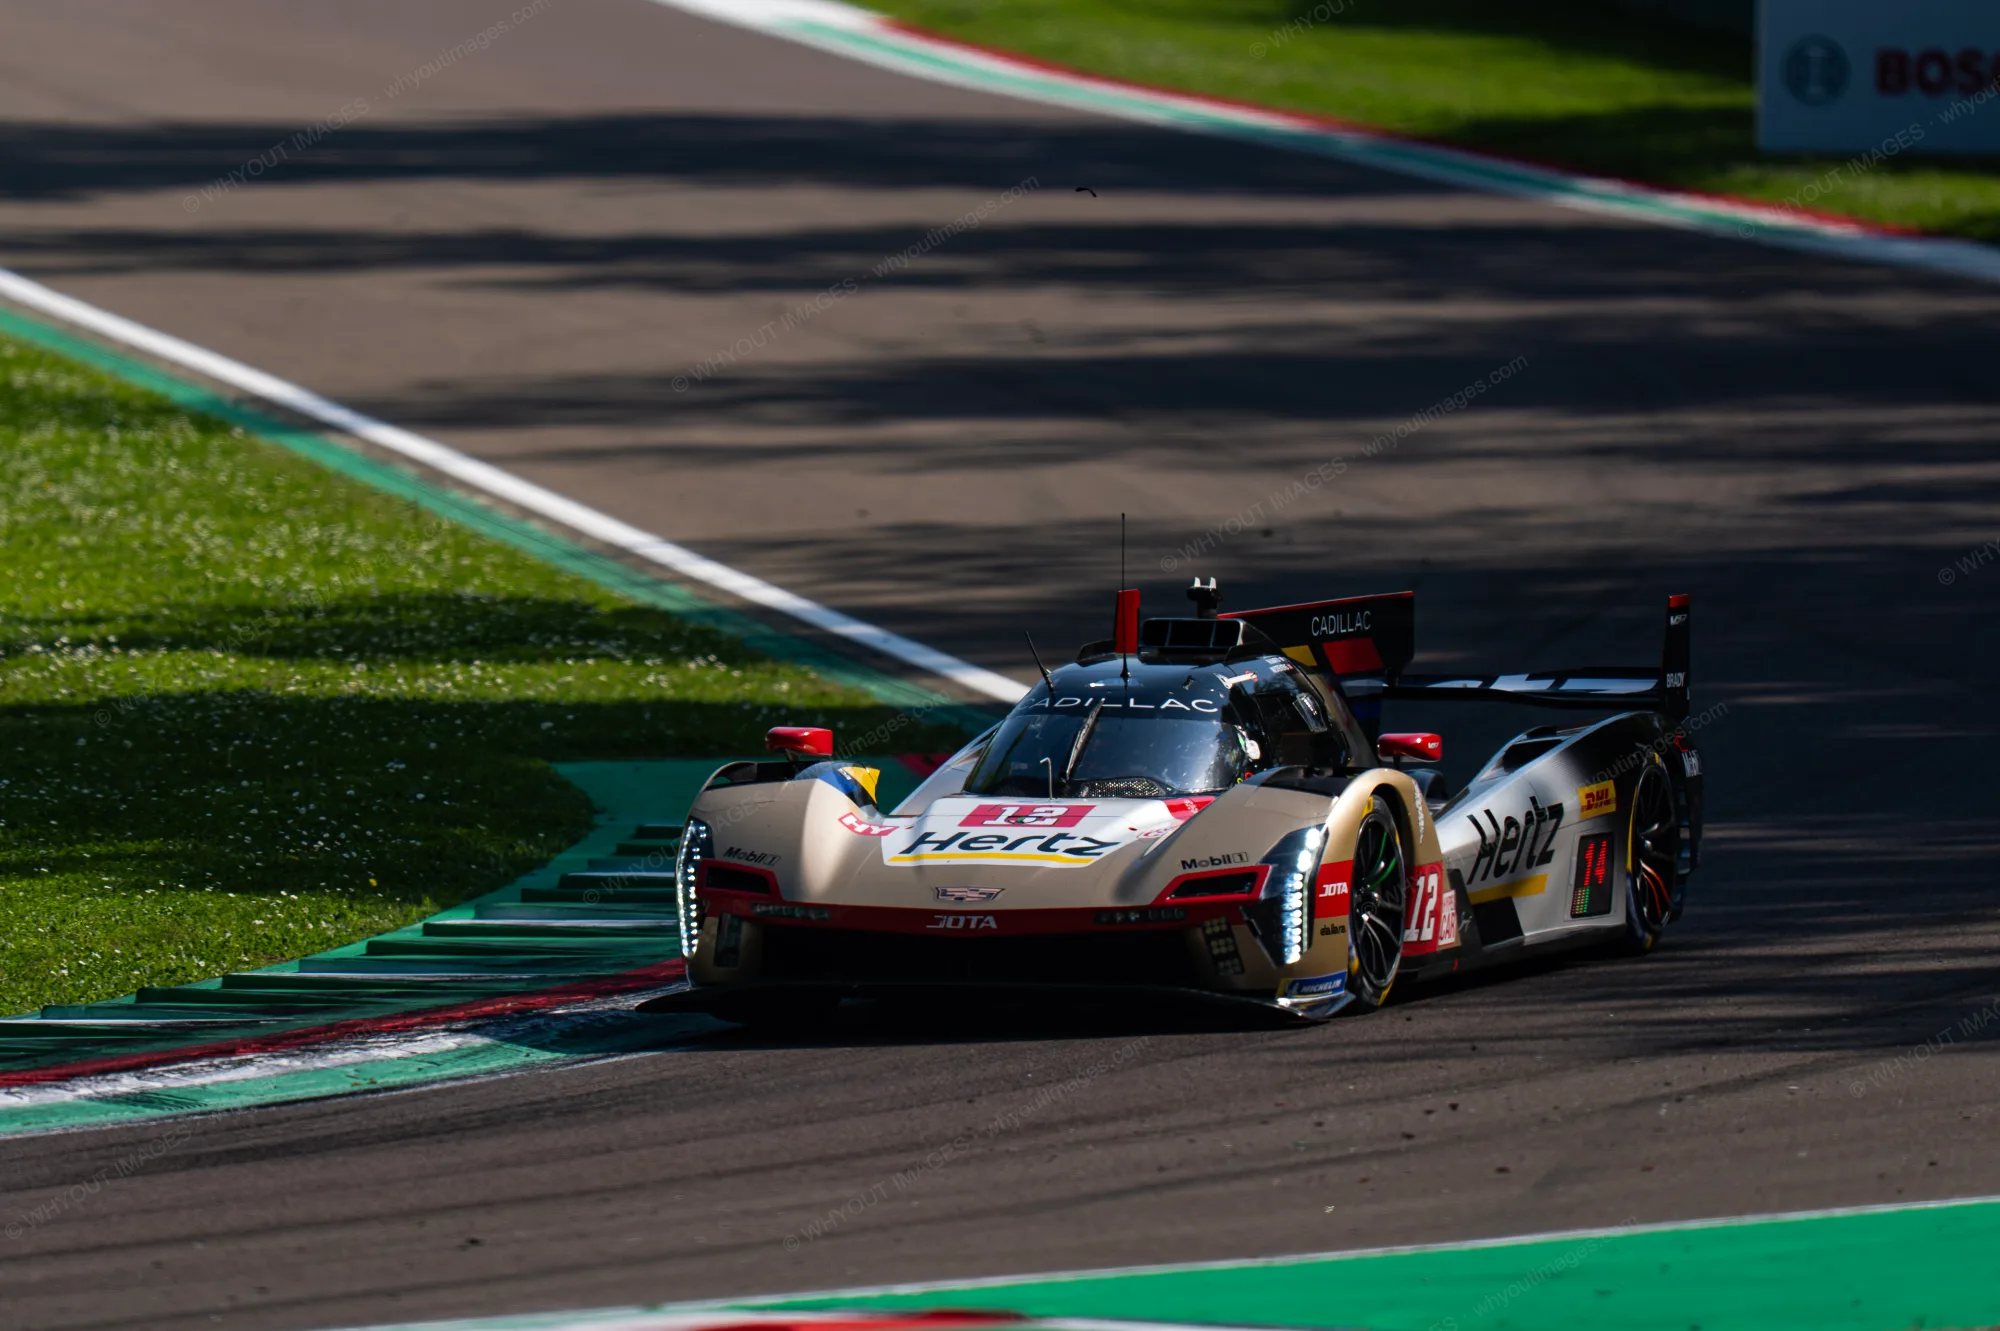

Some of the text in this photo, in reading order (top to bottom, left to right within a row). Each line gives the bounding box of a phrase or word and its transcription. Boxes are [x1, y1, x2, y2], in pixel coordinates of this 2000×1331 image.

[1875, 47, 2000, 95] BOS
[1311, 610, 1372, 637] CADILLAC
[1666, 672, 1686, 688] BRADY
[1585, 788, 1609, 810] DHL
[982, 805, 1070, 826] 12
[898, 831, 1122, 857] Hertz
[1467, 796, 1565, 885] Hertz
[1319, 882, 1349, 898] JOTA
[1403, 872, 1439, 943] 12
[926, 915, 998, 930] JOTA
[1300, 979, 1343, 994] MICHELIN
